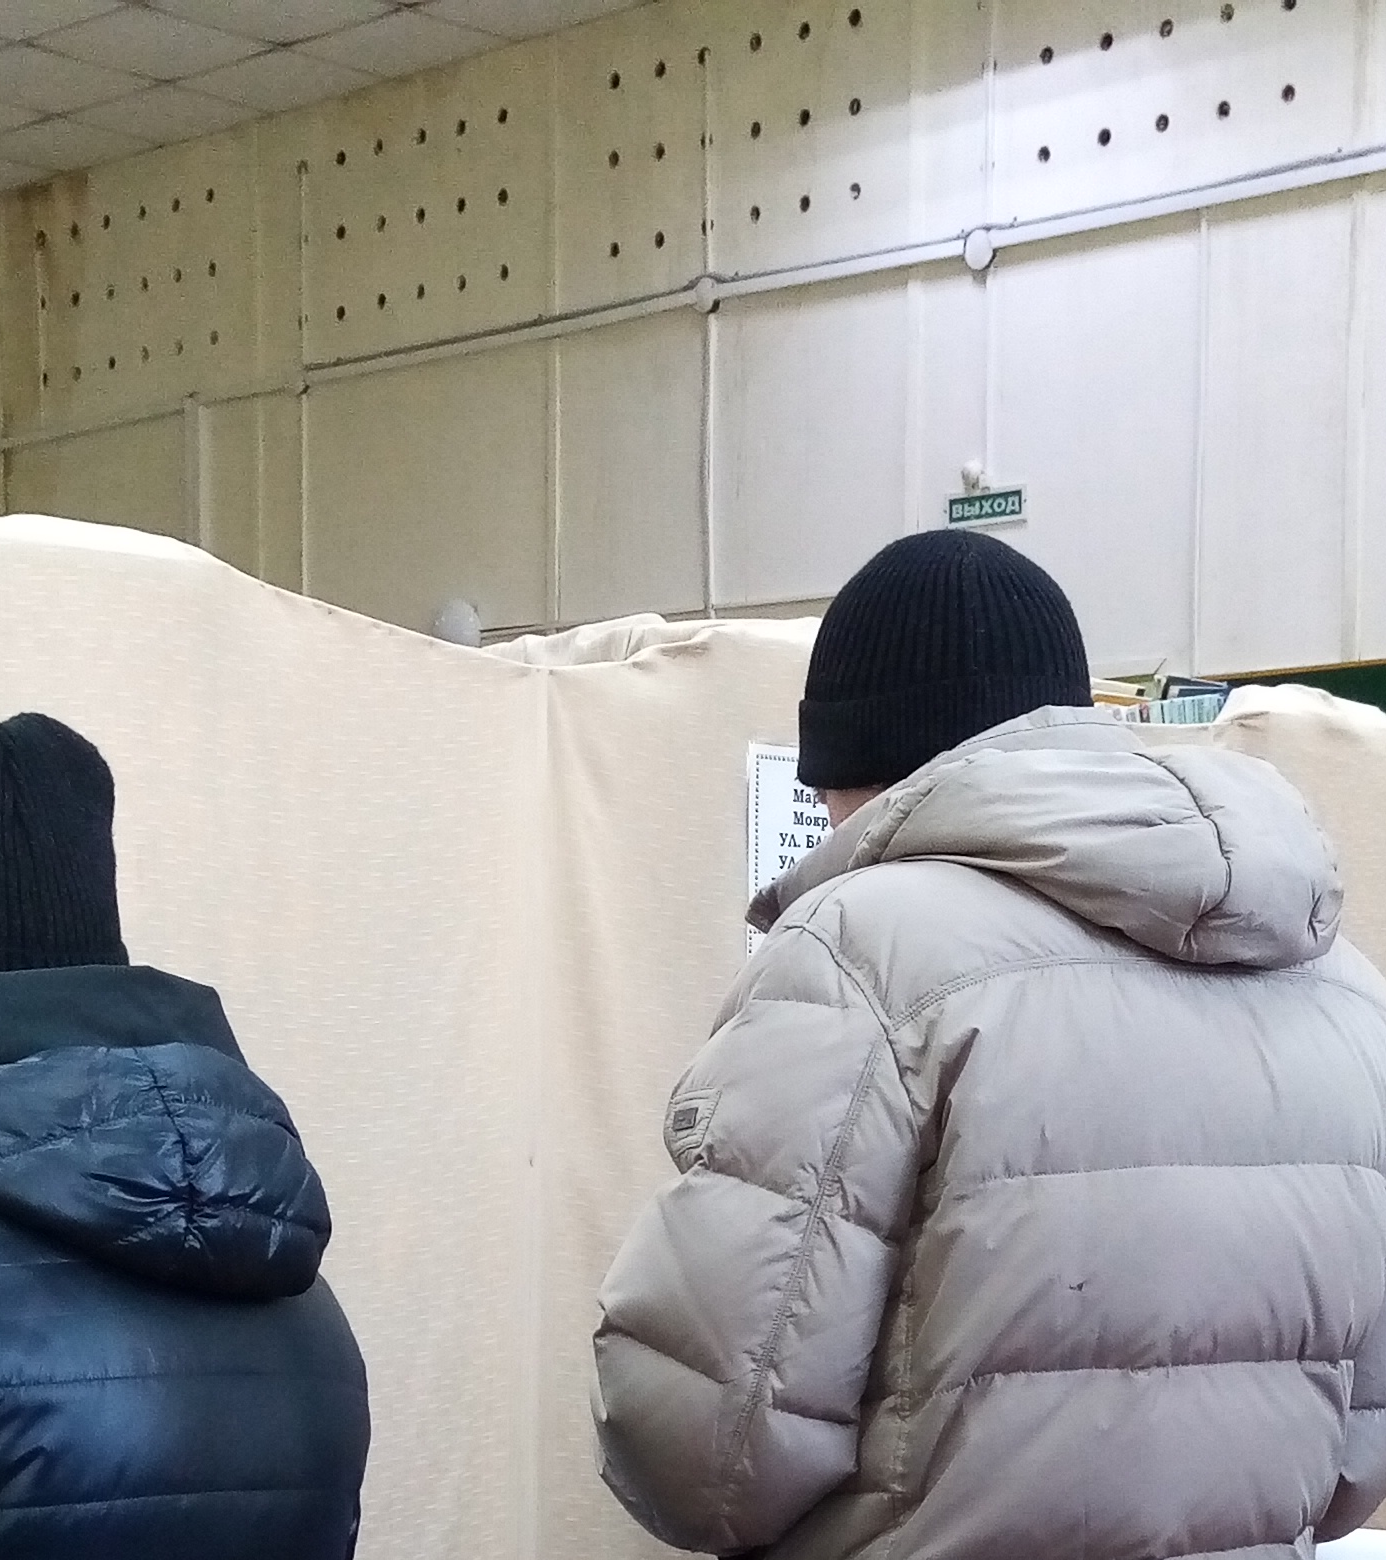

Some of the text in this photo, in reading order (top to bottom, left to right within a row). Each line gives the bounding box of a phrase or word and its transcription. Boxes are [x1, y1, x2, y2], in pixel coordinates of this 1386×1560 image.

[952, 496, 1020, 518] ВЫХОД
[793, 788, 819, 808] Мар
[793, 811, 829, 831] Мокр
[779, 832, 828, 848] УЛ. БА
[778, 855, 796, 870] УЛ
